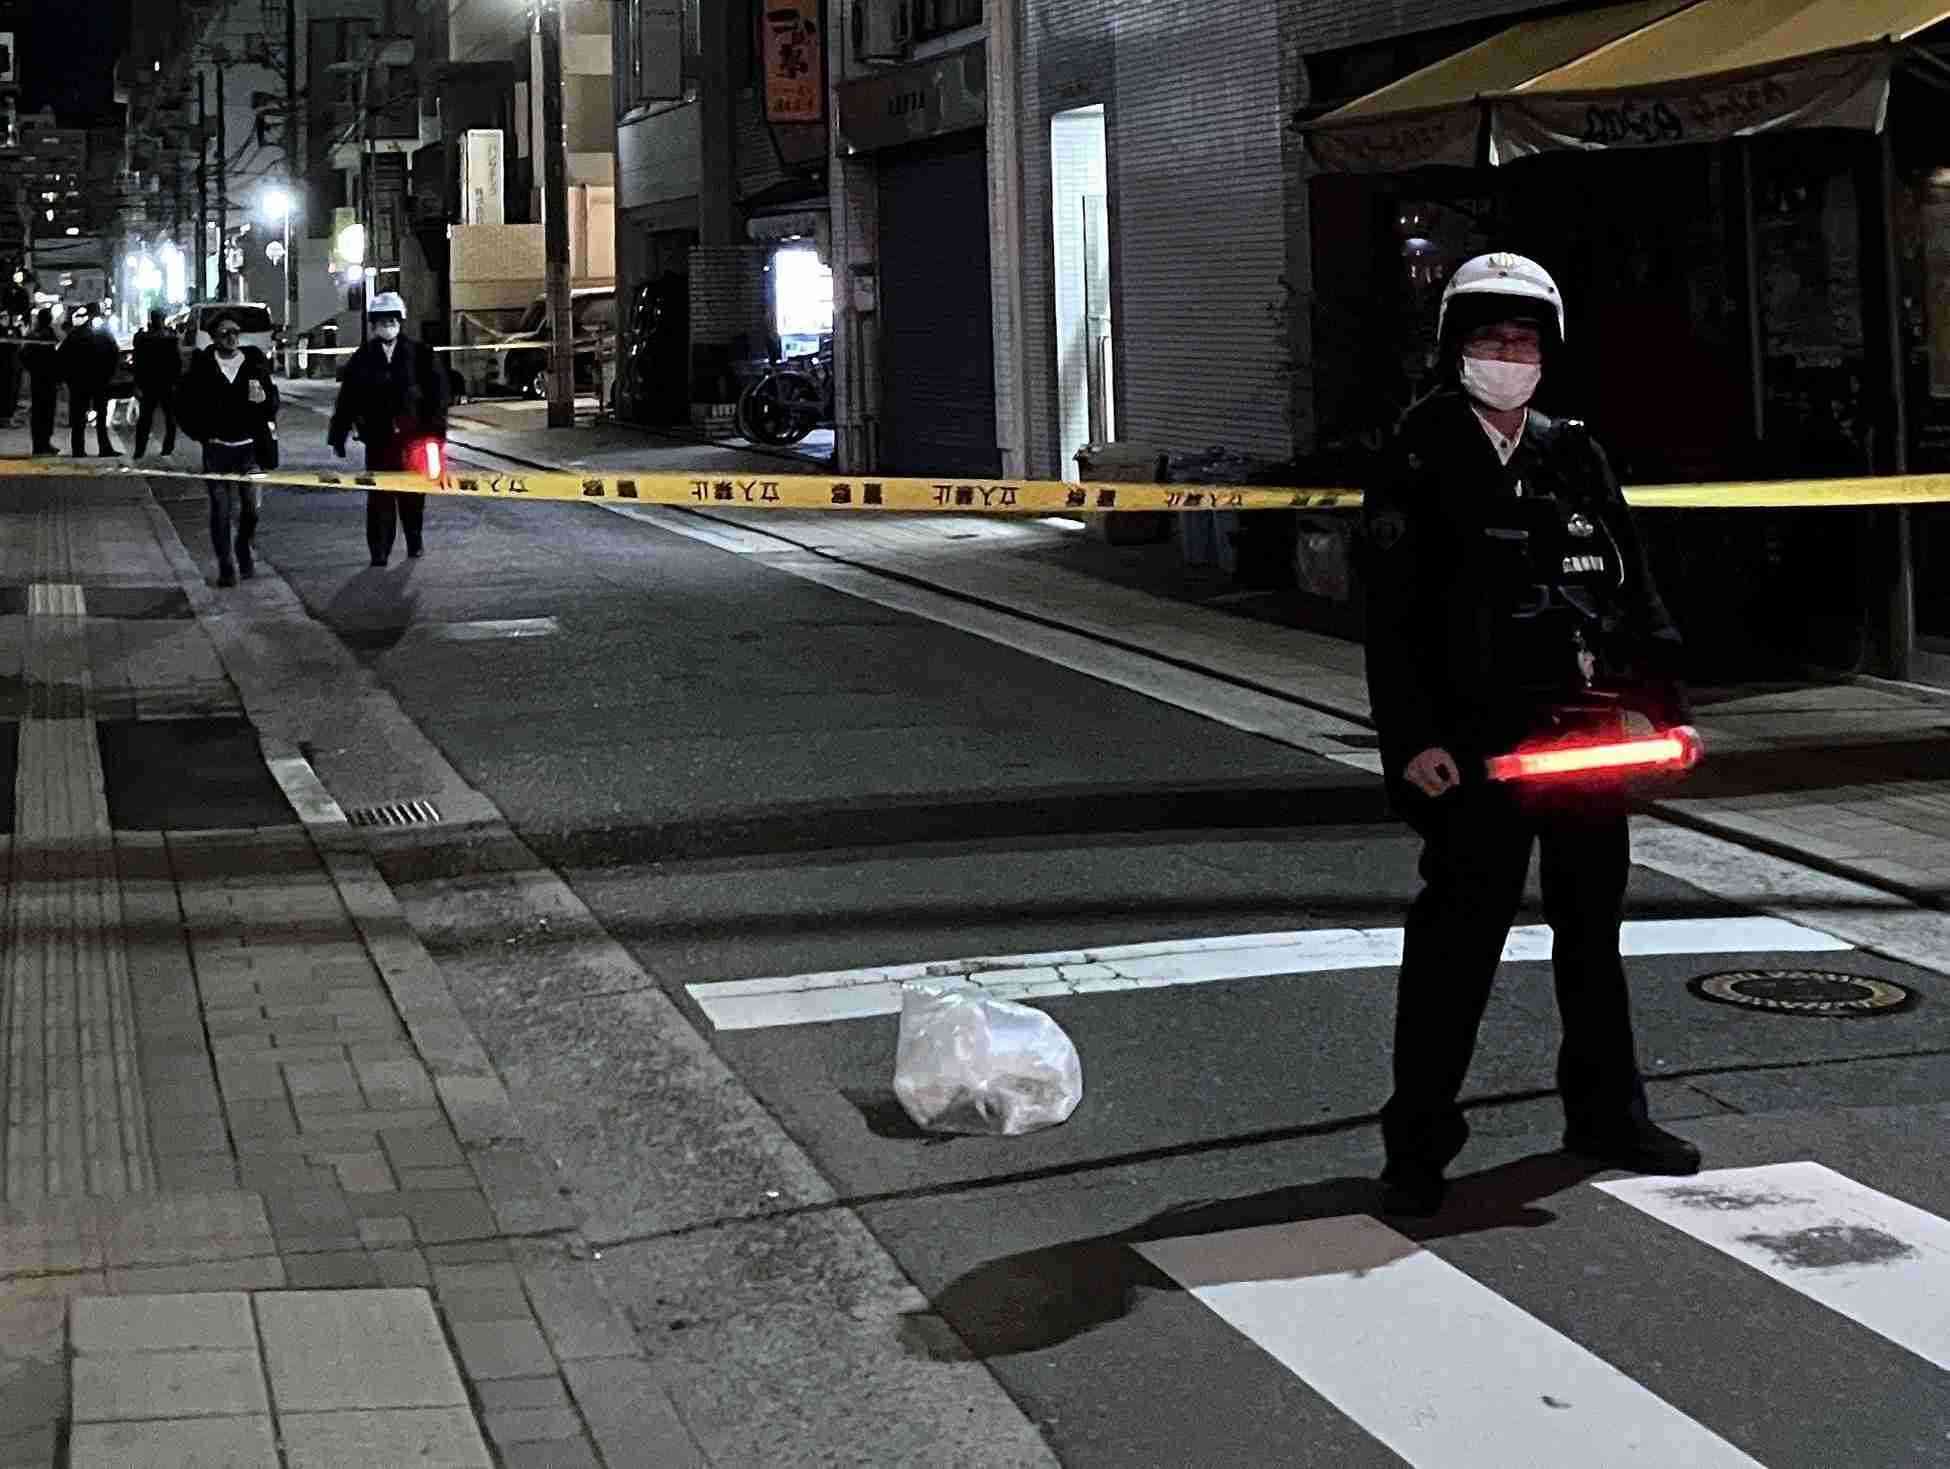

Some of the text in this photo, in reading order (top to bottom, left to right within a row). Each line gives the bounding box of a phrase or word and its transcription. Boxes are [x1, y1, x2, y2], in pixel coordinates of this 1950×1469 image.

[689, 479, 780, 502] 立入禁止
[931, 485, 1020, 506] 立入禁止
